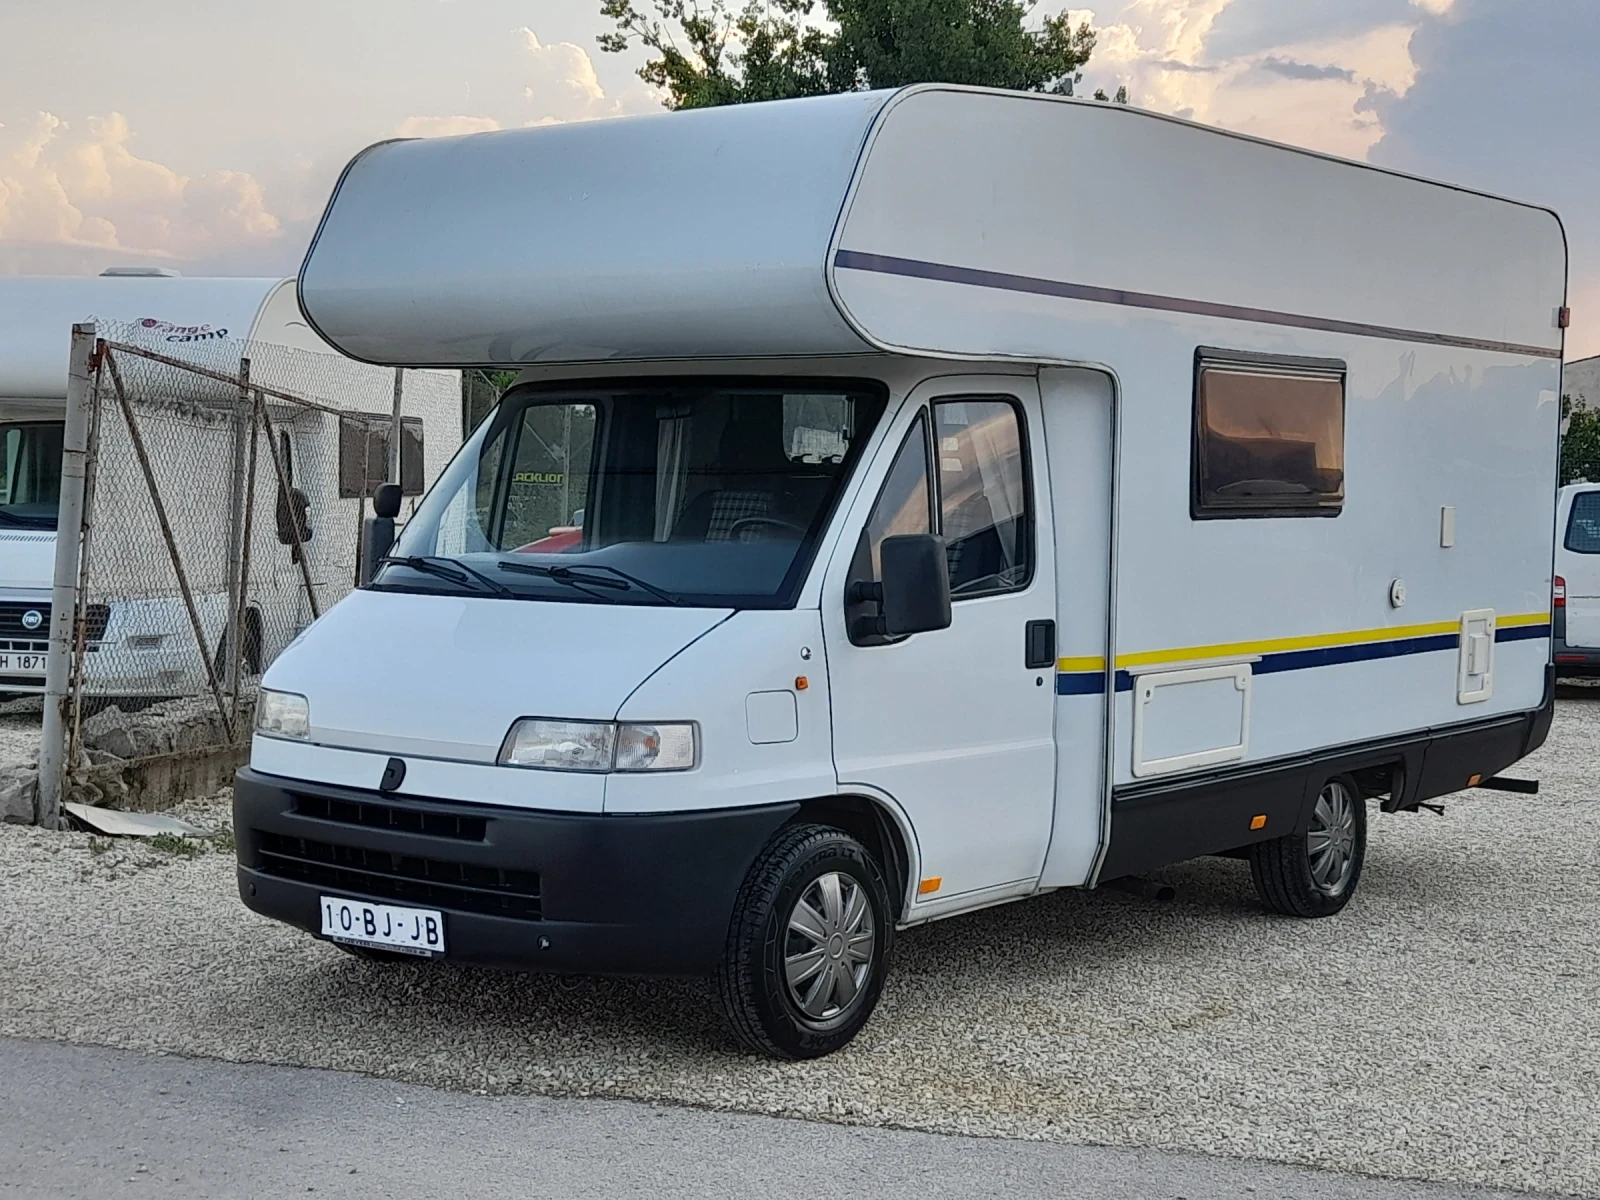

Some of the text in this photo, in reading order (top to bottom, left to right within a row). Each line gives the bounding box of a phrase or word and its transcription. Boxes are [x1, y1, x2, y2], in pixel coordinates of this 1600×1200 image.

[166, 328, 228, 342] camp
[17, 656, 46, 669] 1871
[326, 904, 439, 945] 10-BJ-JB
